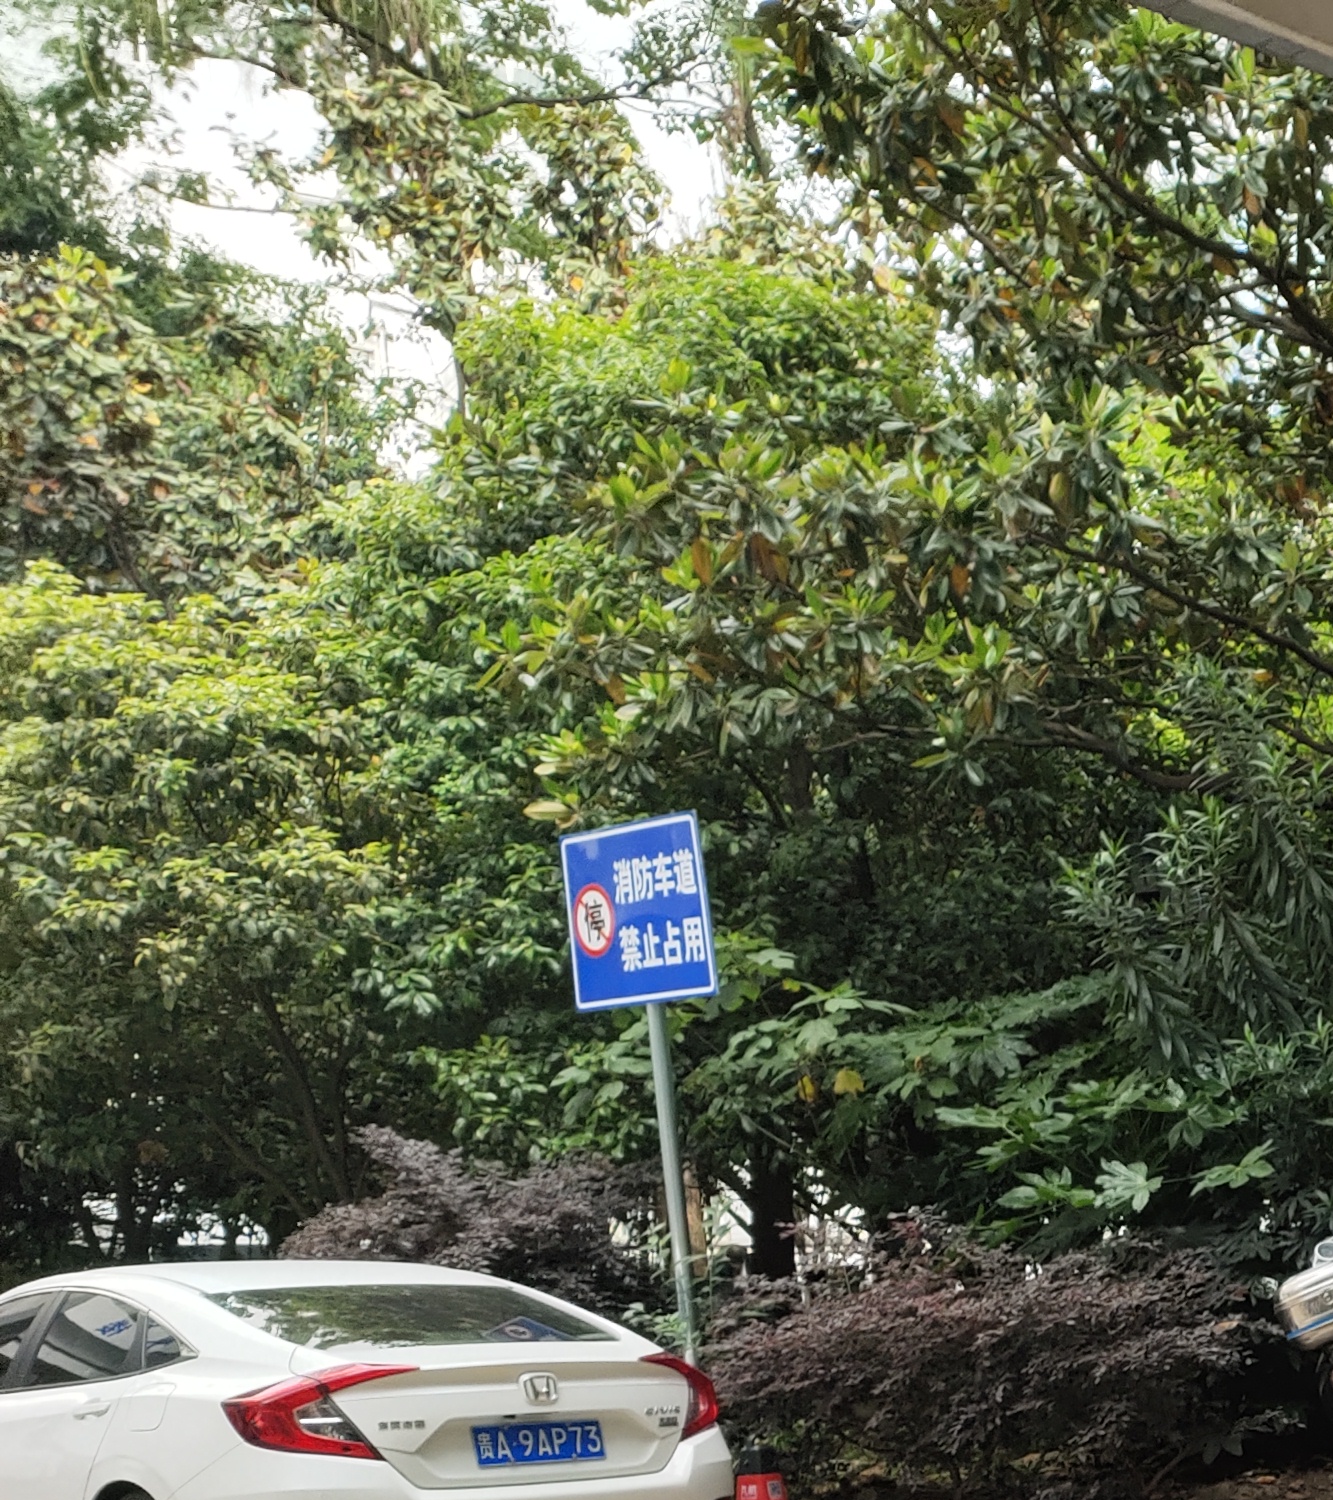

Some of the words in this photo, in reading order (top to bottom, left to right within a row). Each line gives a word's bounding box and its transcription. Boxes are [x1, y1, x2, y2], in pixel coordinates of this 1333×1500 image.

[612, 847, 698, 905] 消防车道
[618, 916, 706, 973] 禁止占用
